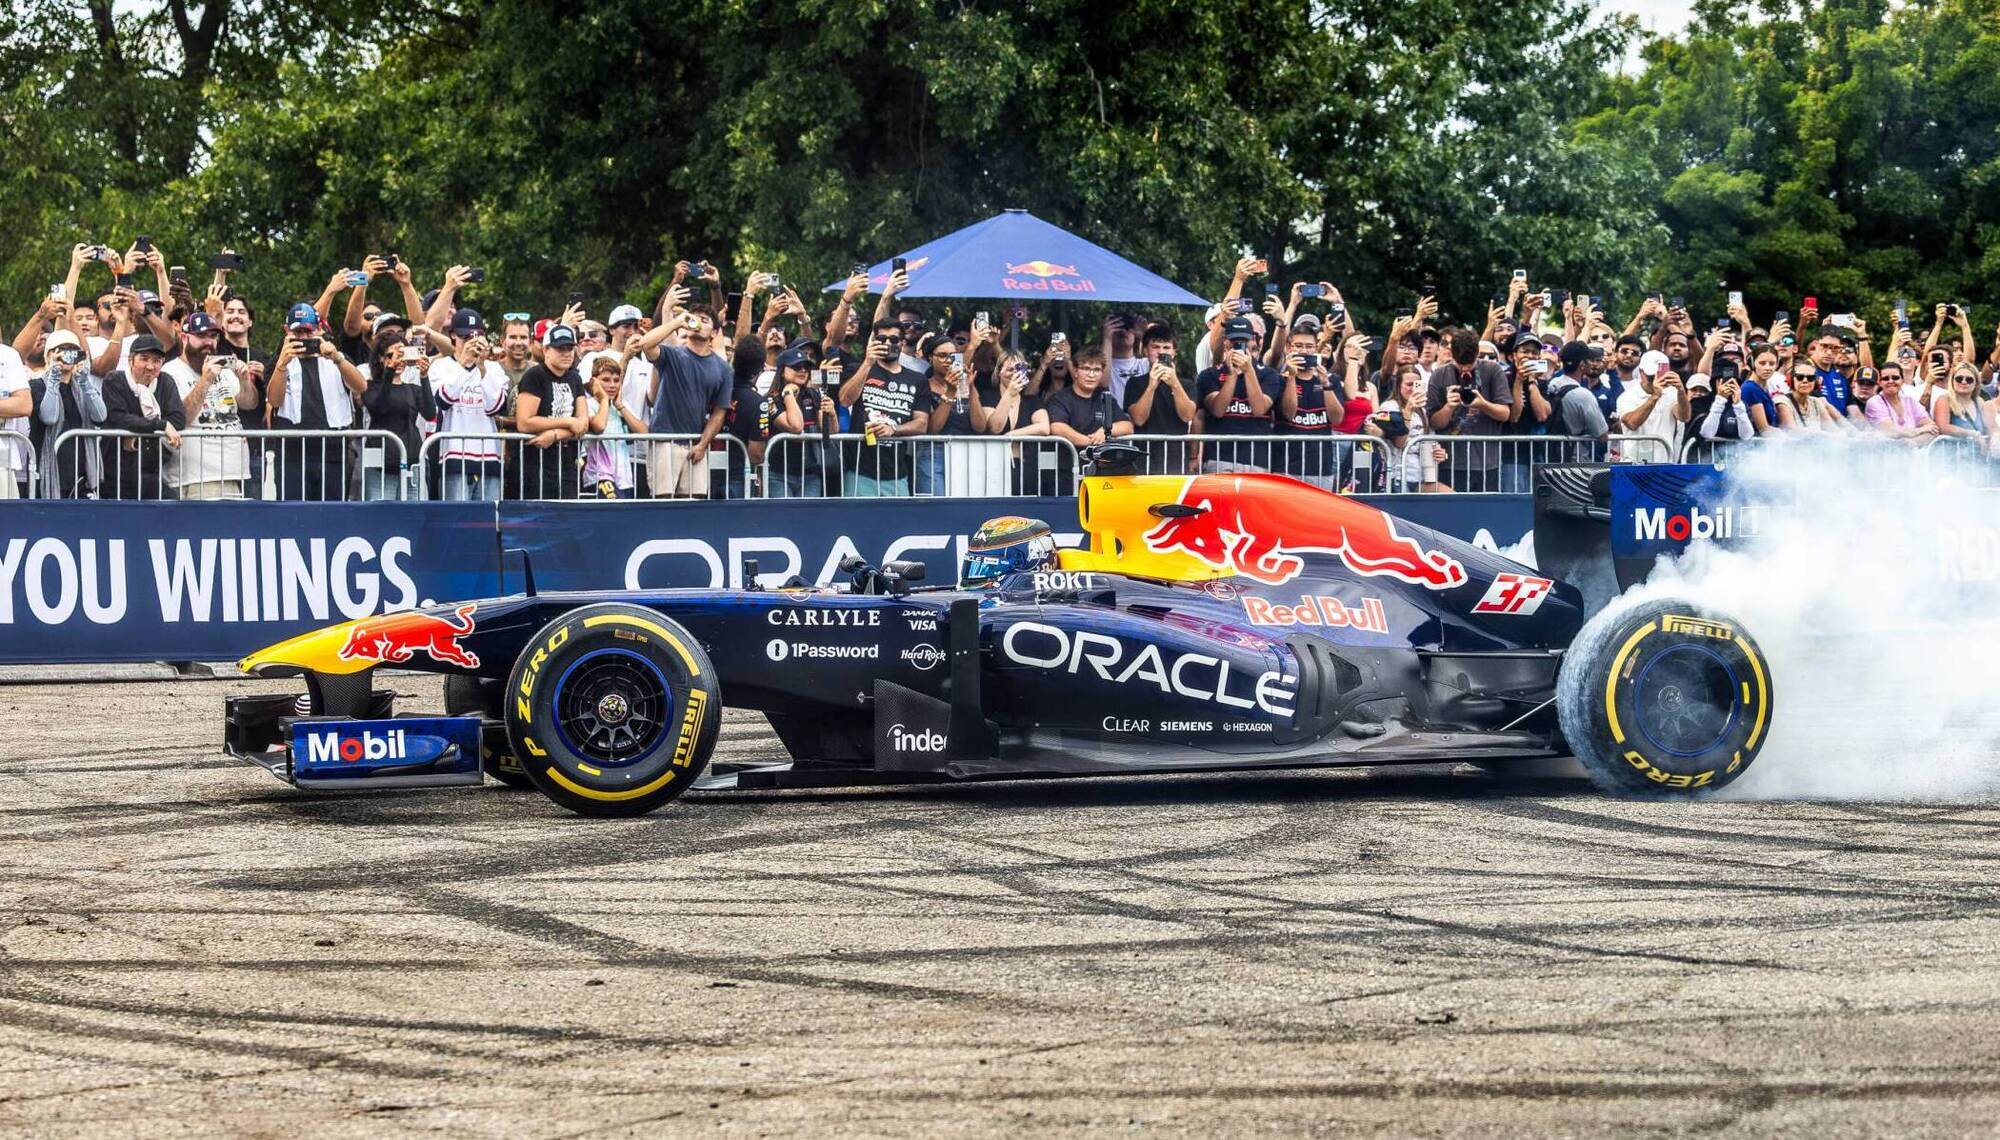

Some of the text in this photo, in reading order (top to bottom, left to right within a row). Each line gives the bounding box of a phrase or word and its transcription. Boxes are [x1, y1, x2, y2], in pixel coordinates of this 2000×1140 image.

[1002, 278, 1096, 292] Red Bull
[1634, 506, 1732, 541] Mobil
[0, 537, 127, 625] YOU
[1034, 572, 1097, 591] ROKT
[767, 609, 881, 626] CARLYLE
[908, 620, 937, 631] VISA
[1240, 595, 1389, 634] Red Bull
[1661, 614, 1733, 640] PIRELLI
[791, 644, 879, 659] 1Password
[901, 651, 946, 661] Hard Rock
[1003, 621, 1297, 717] ORACLE
[518, 626, 569, 756] P ZERO
[672, 688, 708, 768] PIRELLI
[1160, 721, 1213, 731] SIEMENS
[1233, 723, 1272, 732] HEXAGON
[308, 729, 406, 762] Mobil
[1623, 750, 1741, 788] P ZERO
